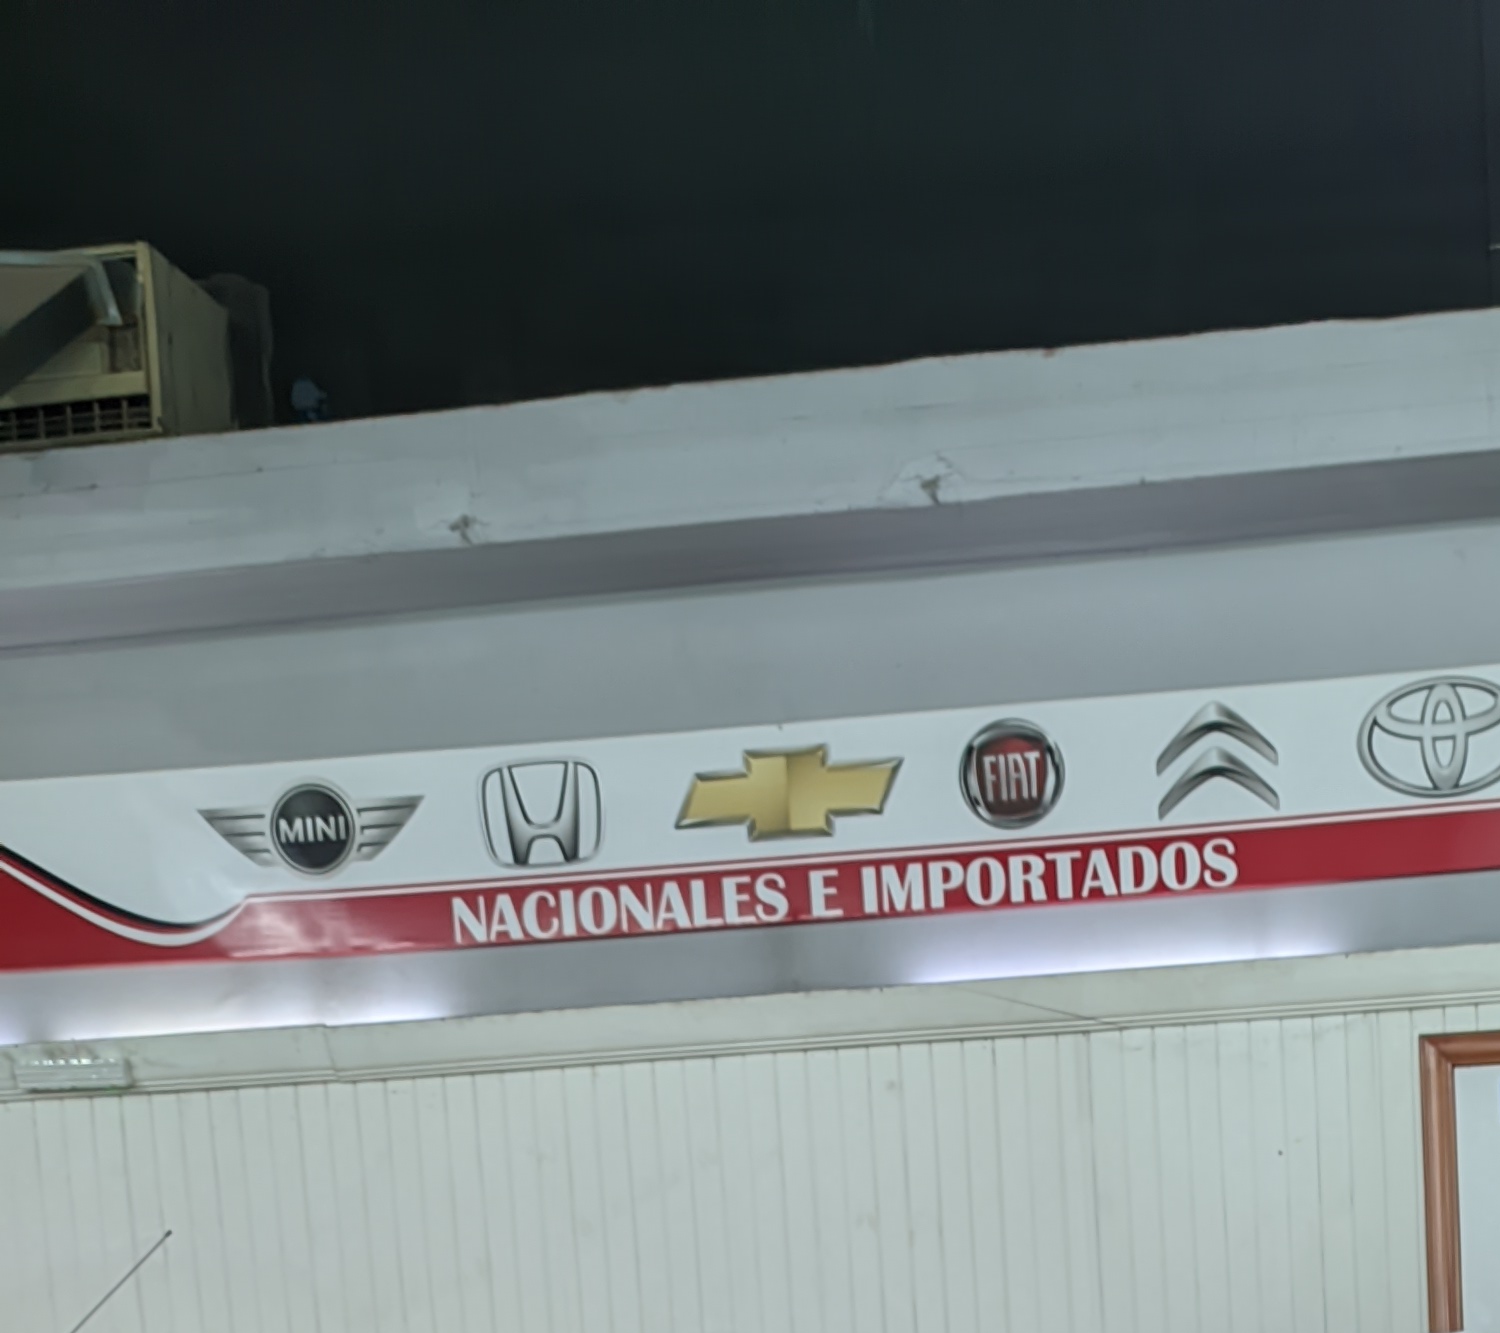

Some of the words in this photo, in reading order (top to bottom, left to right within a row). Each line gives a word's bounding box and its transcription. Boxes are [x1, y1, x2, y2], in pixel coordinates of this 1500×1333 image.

[982, 749, 1042, 802] FIAT
[279, 812, 350, 846] MINI
[451, 873, 789, 946] NACIONALES
[808, 868, 843, 919] E
[861, 838, 1239, 915] IMPORTADOS
